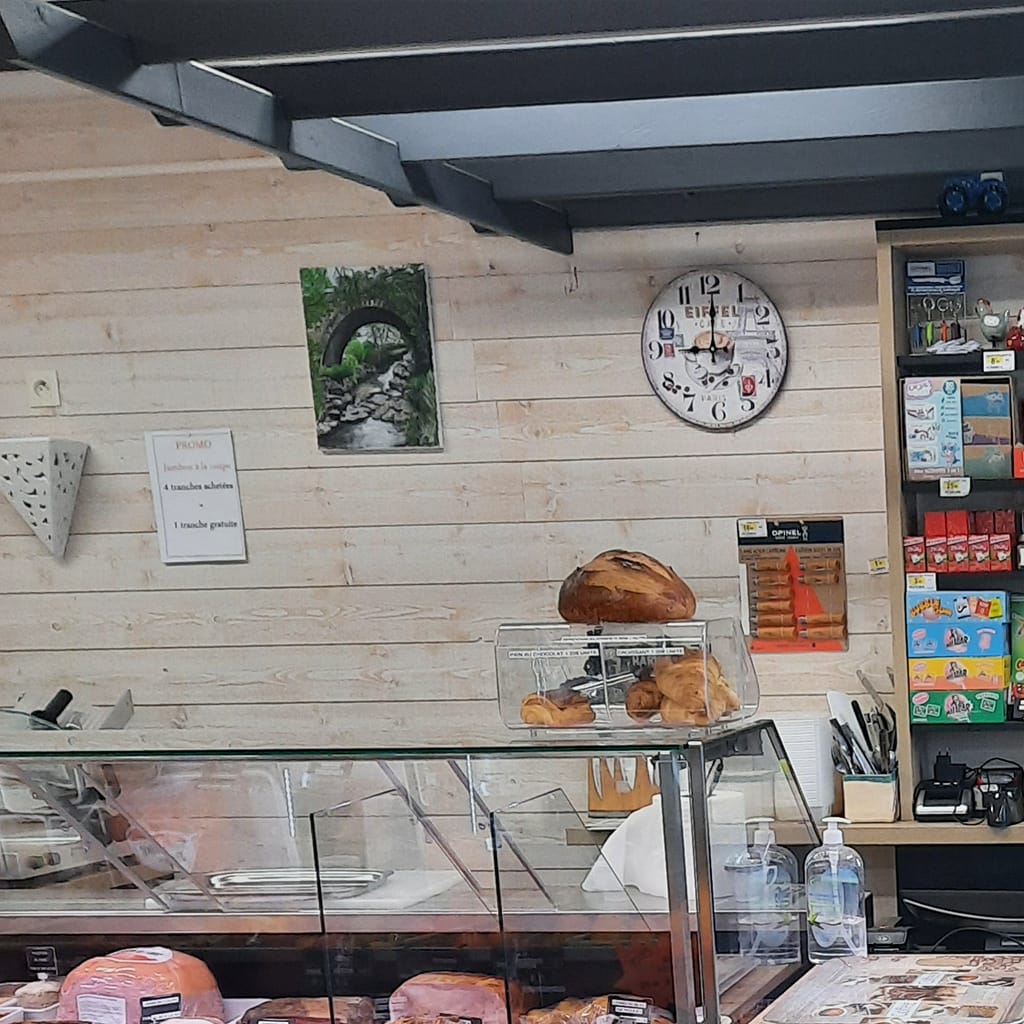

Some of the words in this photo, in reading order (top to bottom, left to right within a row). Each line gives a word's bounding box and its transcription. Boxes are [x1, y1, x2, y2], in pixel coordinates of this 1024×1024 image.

[700, 275, 720, 295] 12
[738, 283, 743, 303] 1
[679, 285, 690, 305] 11
[658, 309, 675, 328] 10
[755, 306, 770, 326] 2
[648, 341, 663, 360] 9
[766, 338, 781, 360] 3
[662, 372, 676, 391] 8
[759, 369, 774, 388] 4
[683, 392, 696, 412] 7
[741, 397, 756, 412] 5
[711, 402, 726, 422] 6
[175, 440, 212, 450] PROMO
[771, 529, 801, 537] OPINEL
